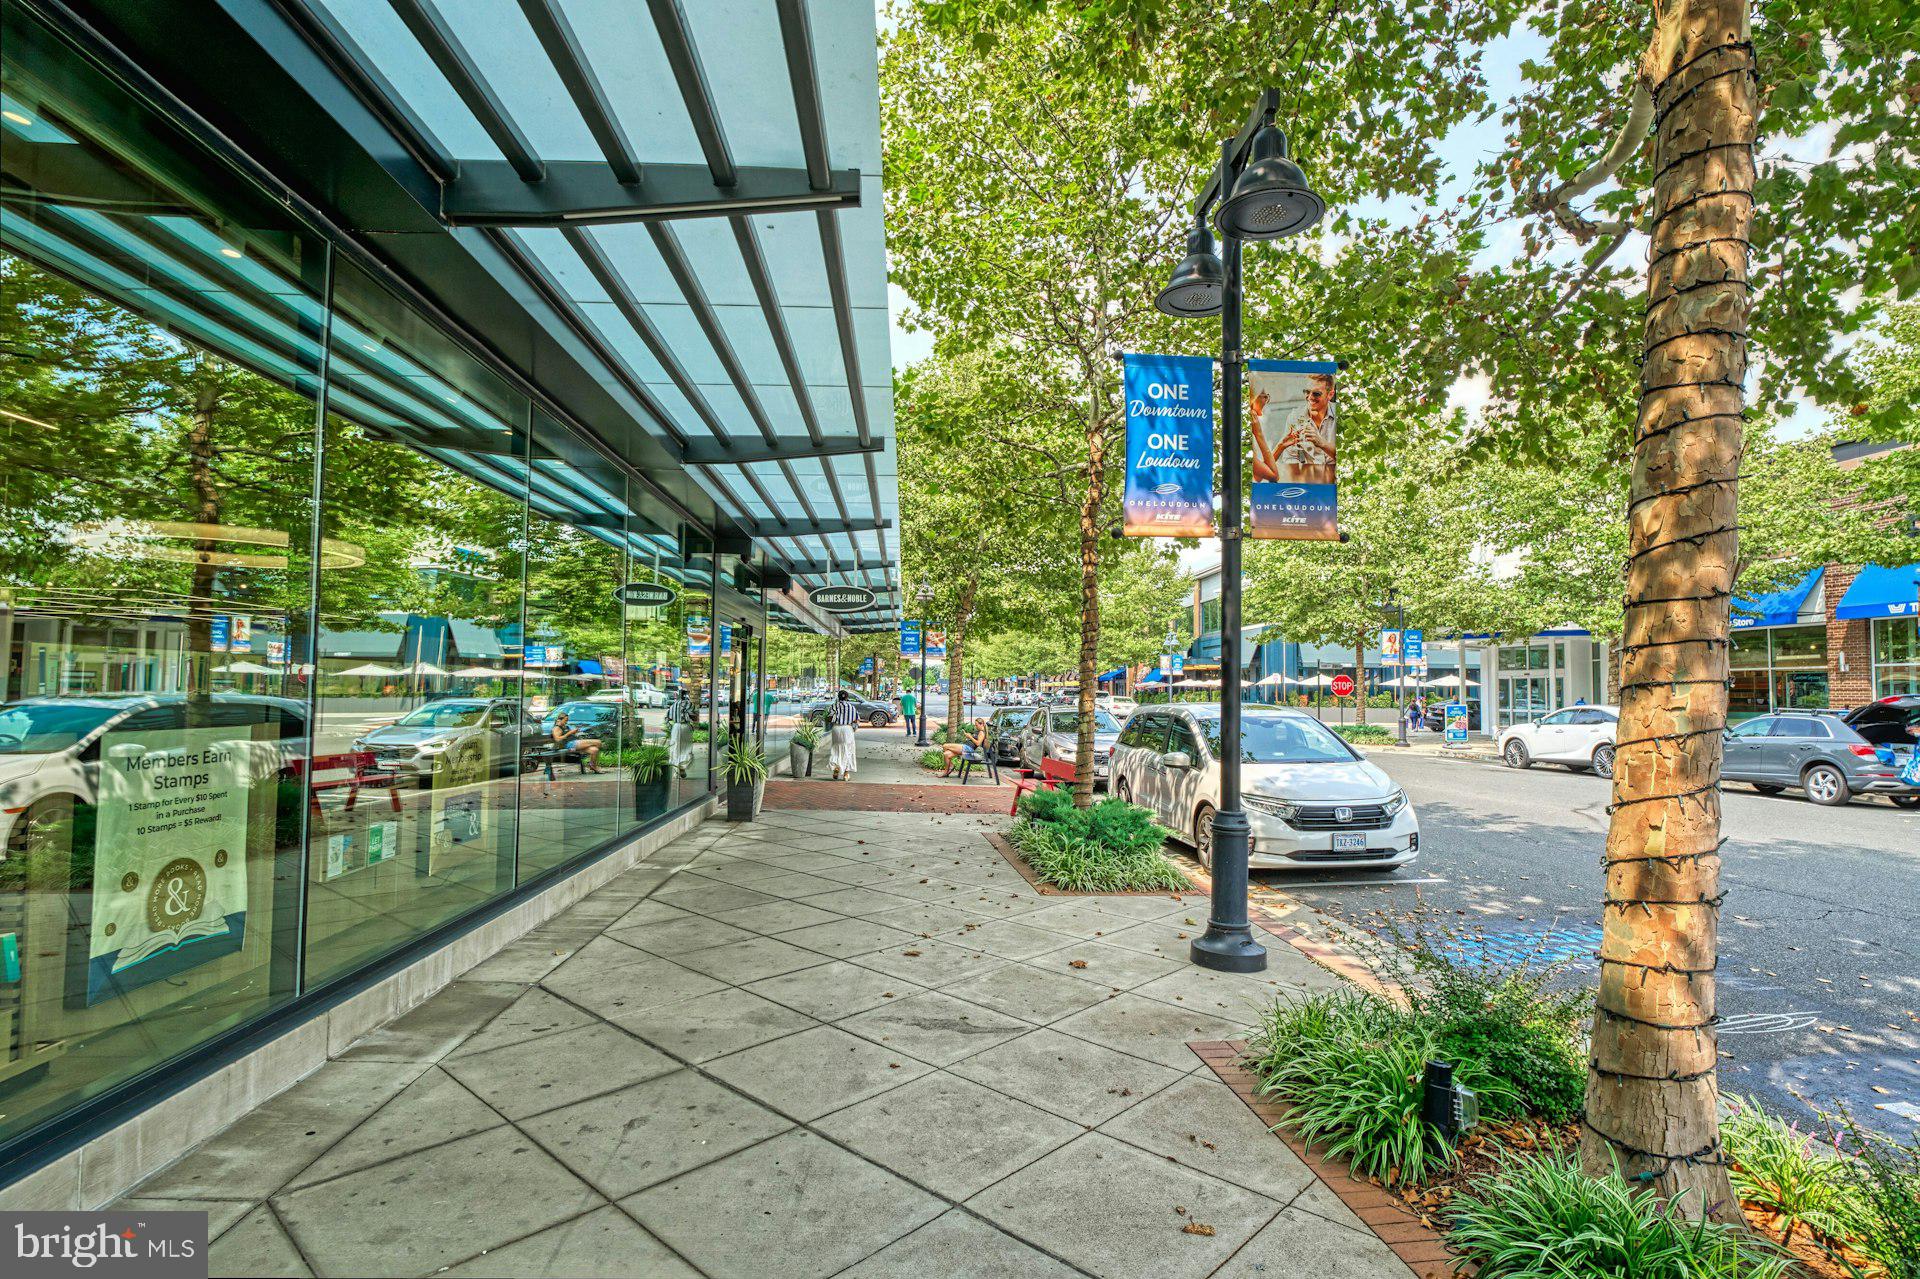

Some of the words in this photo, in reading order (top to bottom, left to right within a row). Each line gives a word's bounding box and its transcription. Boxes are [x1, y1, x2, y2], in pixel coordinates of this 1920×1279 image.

[1148, 383, 1189, 401] ONE
[1129, 400, 1208, 419] Downtown
[1147, 433, 1189, 451] ONE
[1136, 451, 1201, 469] Loudoun
[1732, 618, 1755, 627] Store
[1333, 682, 1352, 690] STOP
[126, 753, 199, 772] Members
[202, 751, 231, 764] Earn
[153, 773, 209, 790] Stamps
[134, 801, 161, 812] Stamp
[174, 796, 195, 806] Every
[195, 794, 208, 802] $10
[208, 791, 228, 801] Spent
[156, 812, 164, 820] in
[172, 807, 205, 818] Purchase
[137, 827, 146, 836] 10
[147, 822, 177, 834] Stamps
[184, 818, 193, 828] $5
[194, 814, 222, 825] Reward!
[164, 877, 192, 916] &
